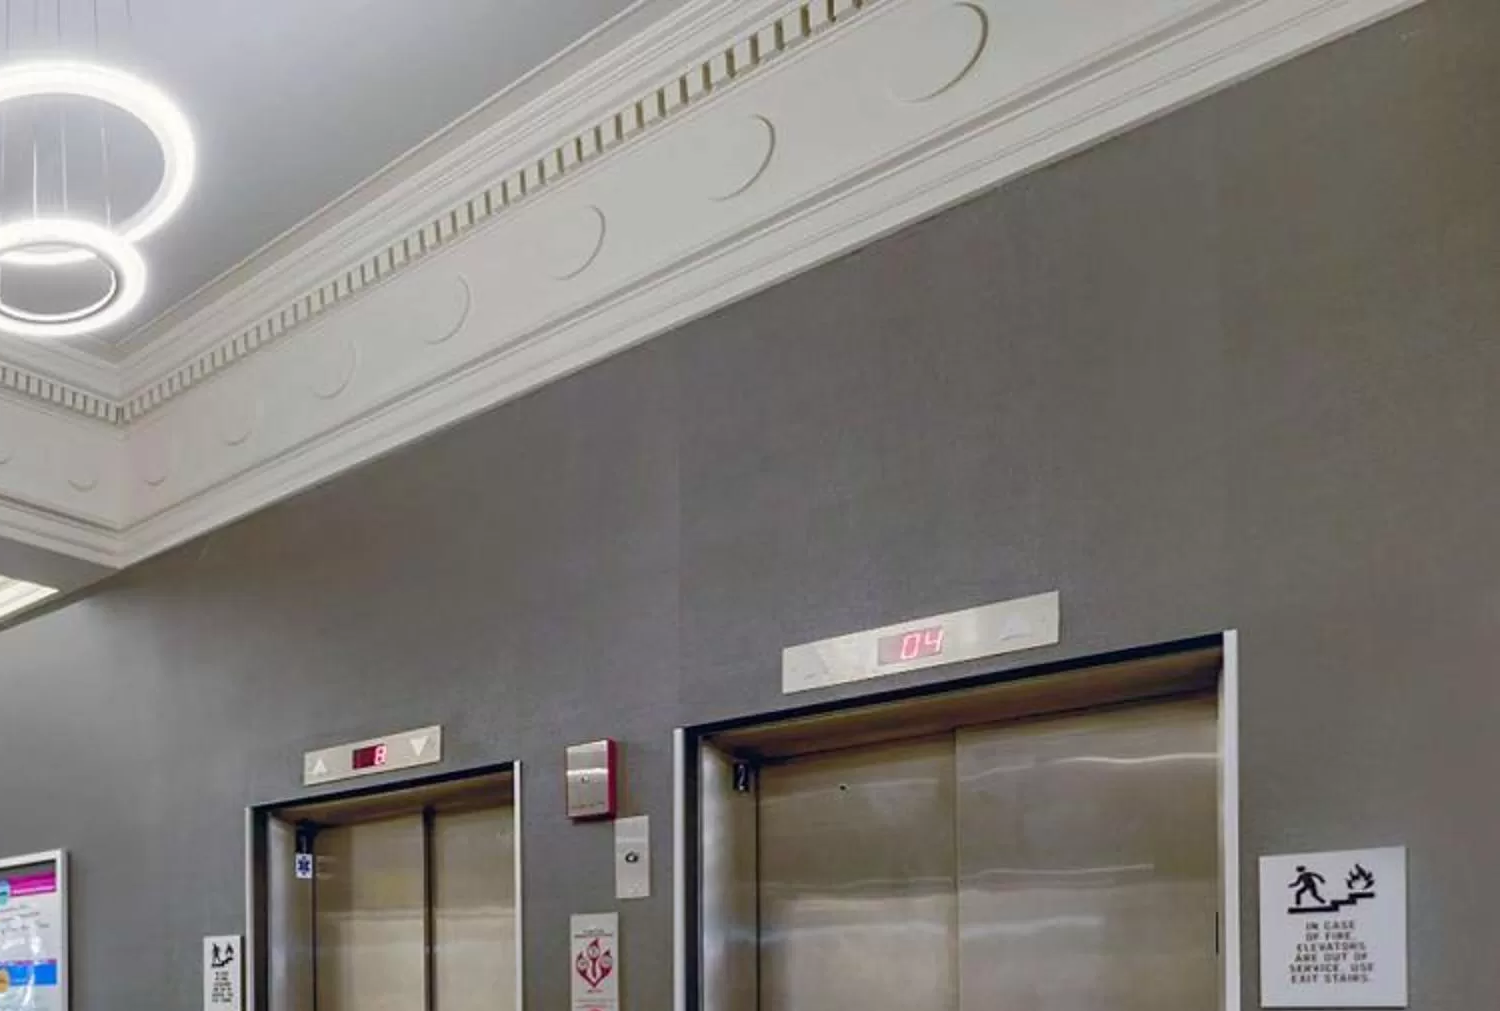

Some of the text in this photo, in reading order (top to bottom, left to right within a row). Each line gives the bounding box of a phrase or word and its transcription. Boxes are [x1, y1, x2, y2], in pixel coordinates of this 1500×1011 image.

[902, 631, 944, 660] 04
[1323, 920, 1354, 929] CASE
[1296, 942, 1366, 952] ELEVATORS
[1294, 953, 1317, 962] ARE
[1323, 952, 1347, 962] OUT
[1351, 962, 1374, 972] USE
[1291, 974, 1317, 984] EXIT
